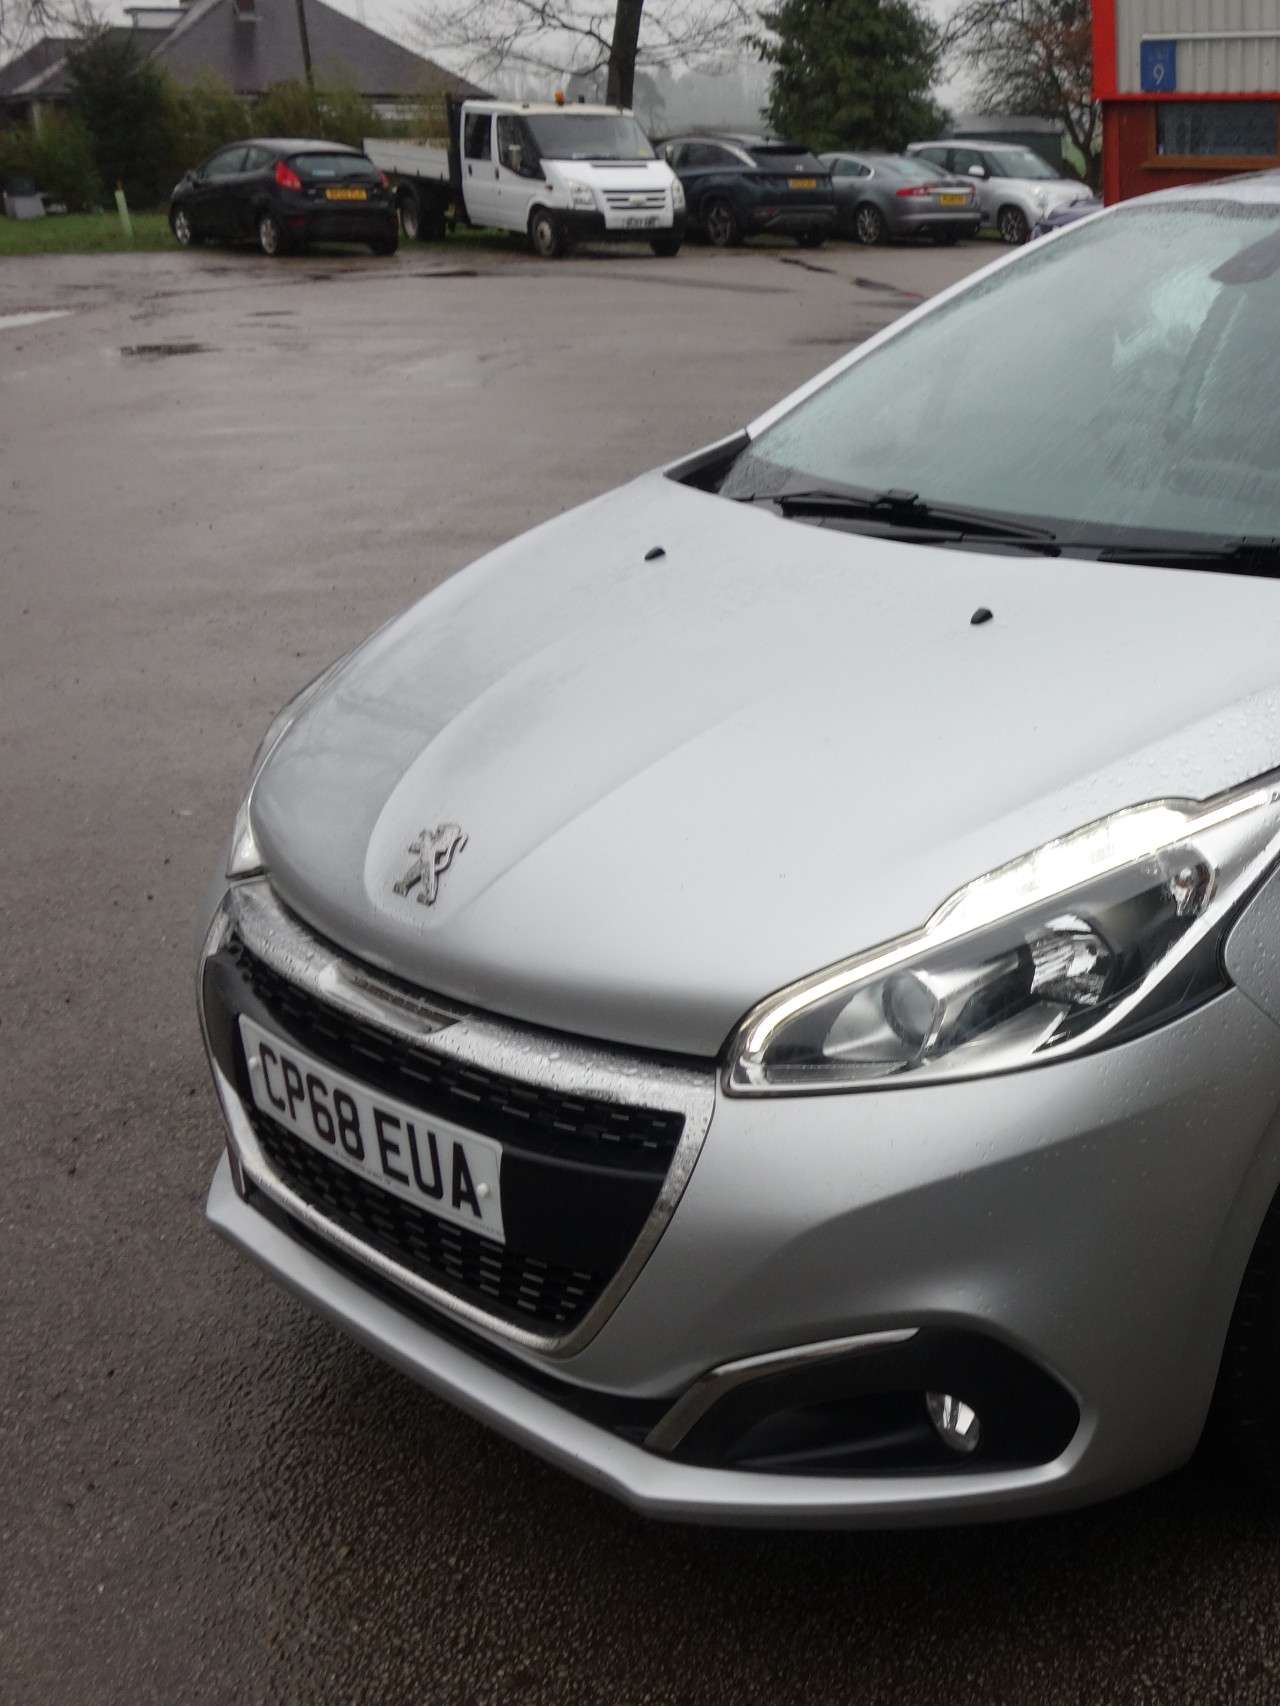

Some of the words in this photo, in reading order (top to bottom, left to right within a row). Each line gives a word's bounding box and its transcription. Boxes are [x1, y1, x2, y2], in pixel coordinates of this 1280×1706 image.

[1153, 64, 1165, 85] 9
[259, 1042, 365, 1161] CP68
[373, 1106, 483, 1219] EUA
